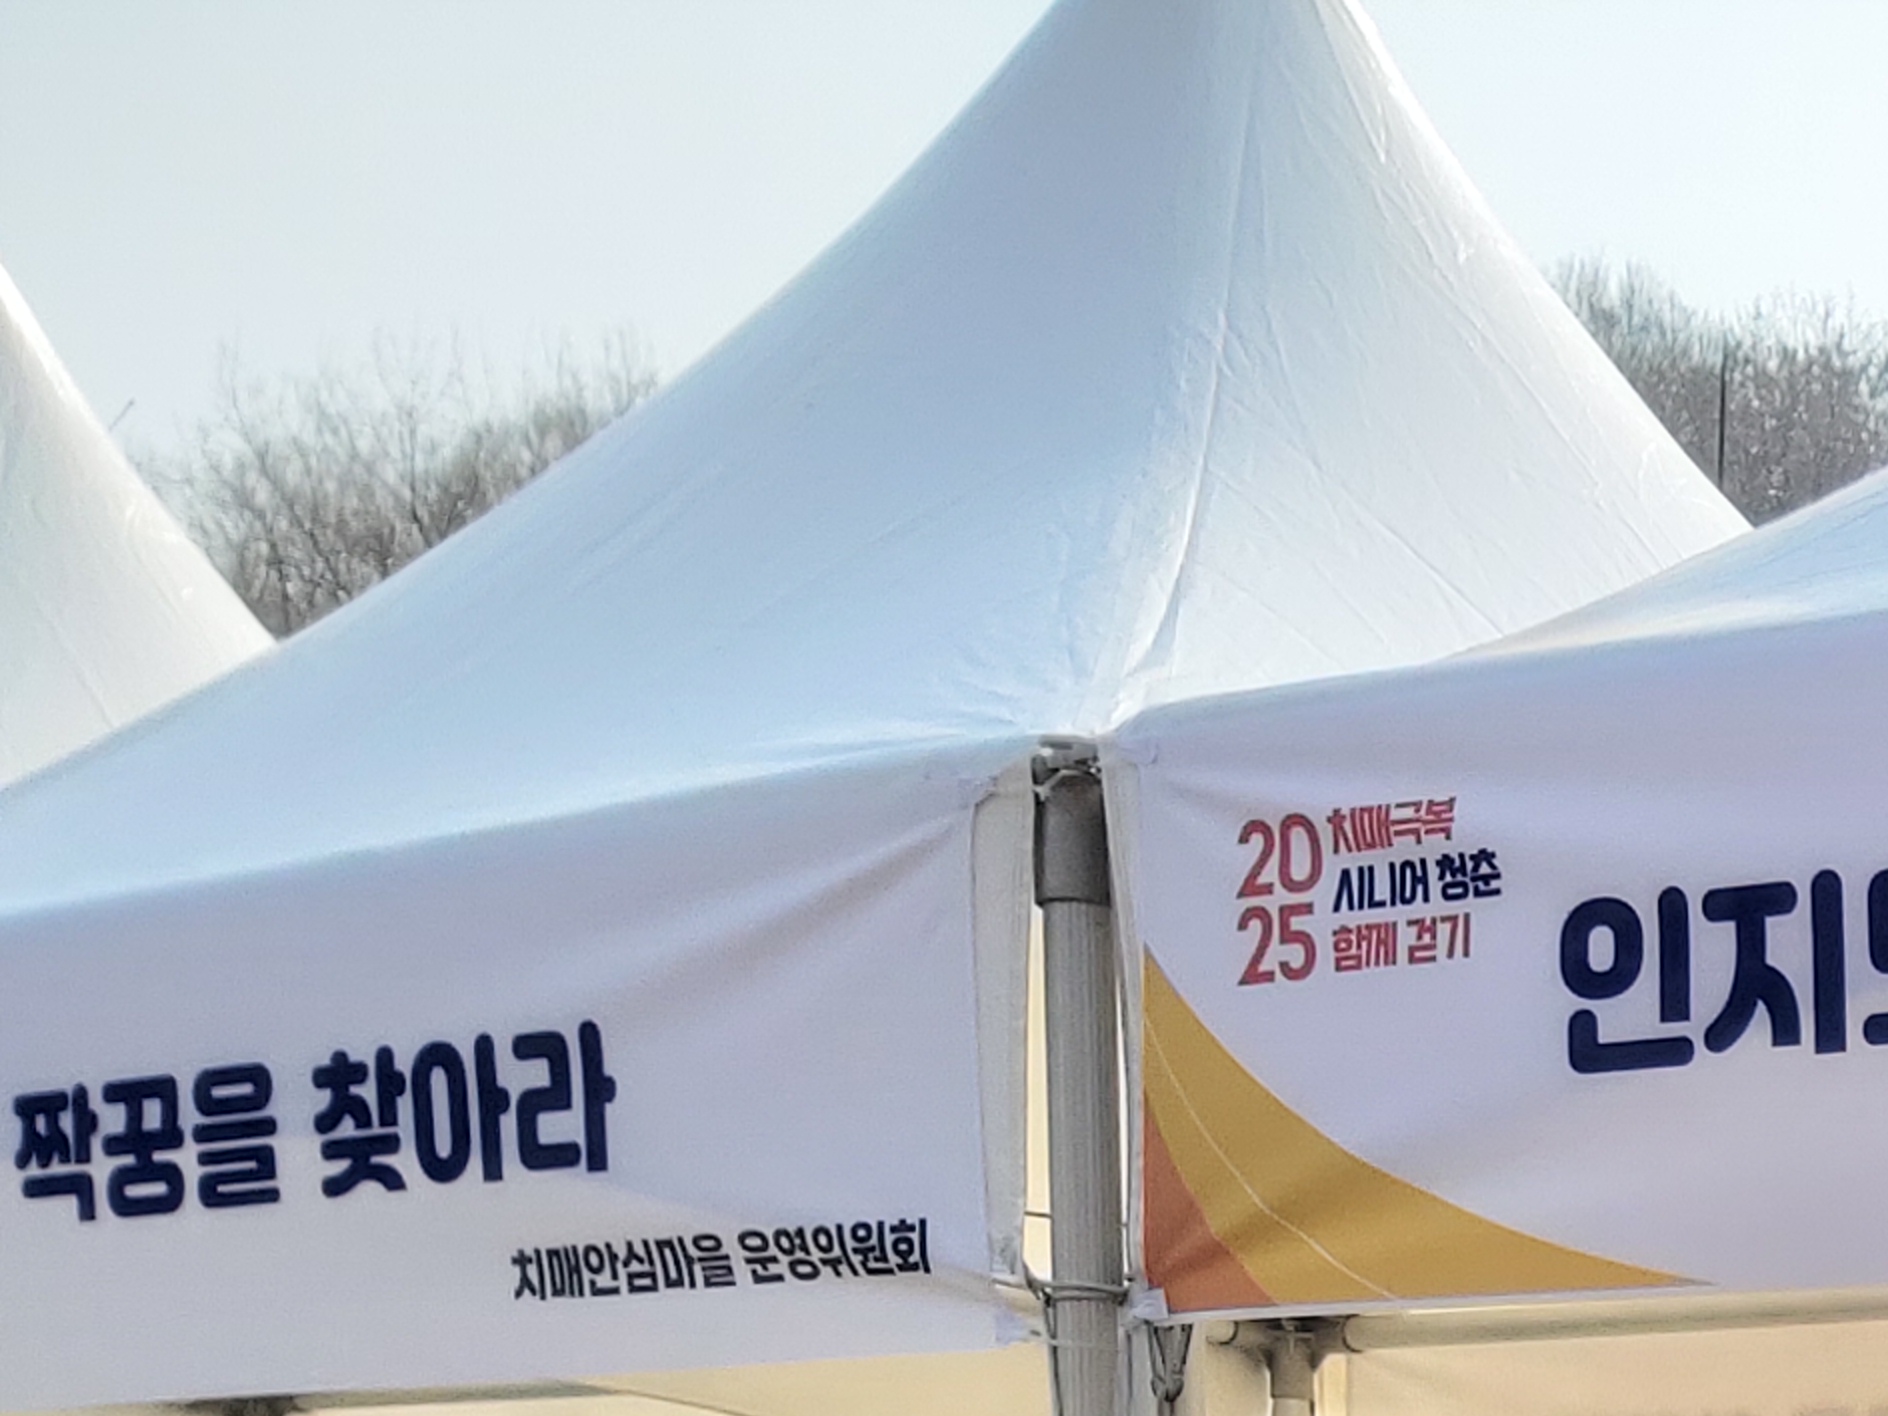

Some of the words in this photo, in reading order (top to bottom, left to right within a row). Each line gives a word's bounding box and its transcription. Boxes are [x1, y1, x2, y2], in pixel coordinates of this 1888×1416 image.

[1235, 812, 1323, 899] 20
[1331, 796, 1457, 855] 치매극복
[1333, 855, 1431, 913] 시니어
[1435, 847, 1502, 903] 청춘
[1235, 903, 1317, 987] 25
[1331, 919, 1398, 974] 함께
[1406, 912, 1471, 965] 걷기
[12, 1059, 281, 1223] 짝꿍을
[311, 1019, 617, 1200] 찾아라
[512, 1233, 738, 1302] 치매안심마을
[738, 1217, 933, 1284] 운영위원회
